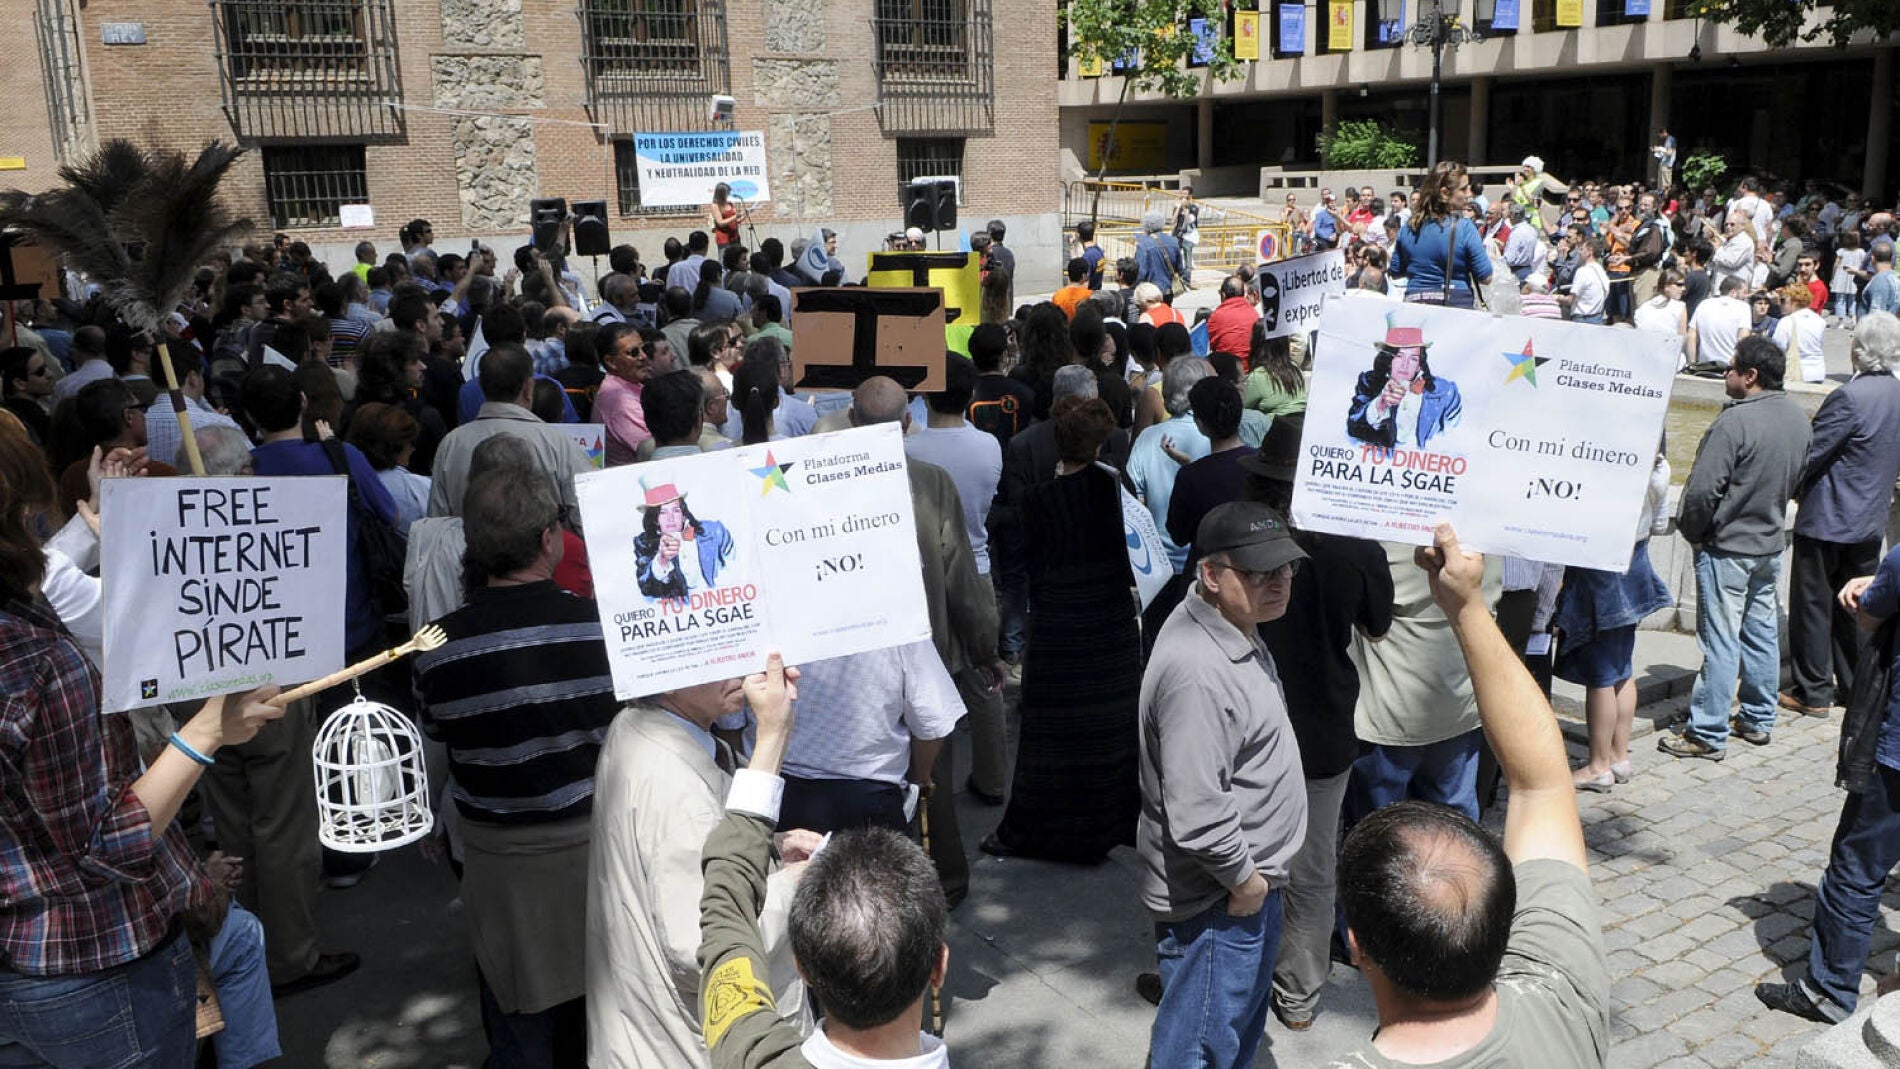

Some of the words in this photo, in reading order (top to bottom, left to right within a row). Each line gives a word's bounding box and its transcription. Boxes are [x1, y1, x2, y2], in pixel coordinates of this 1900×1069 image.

[637, 138, 656, 149] POR
[659, 138, 676, 149] LOS
[678, 137, 724, 148] DERECHOS
[660, 153, 671, 163] LA
[673, 151, 743, 163] UNIVERSALIDAD
[647, 168, 653, 179] Y
[655, 167, 716, 179] NEUTRALIDAD
[719, 166, 729, 176] DE
[731, 166, 742, 177] LA
[744, 165, 760, 176] RED
[1331, 261, 1343, 281] de
[1559, 359, 1633, 380] Plataforma
[1556, 375, 1605, 391] Clases
[1608, 382, 1663, 399] Medias
[1310, 445, 1354, 461] QUIERO
[1360, 443, 1386, 465] TU
[1392, 450, 1467, 476] DINERO
[1488, 430, 1531, 451] Con
[1537, 438, 1566, 457] mi
[1571, 441, 1639, 467] dinero
[803, 452, 870, 471] Plataforma
[806, 468, 851, 485] Clases
[854, 460, 903, 477] Medias
[1312, 460, 1363, 483] PARA
[1369, 466, 1395, 486] LA
[1401, 469, 1456, 494] $GAE
[1526, 478, 1582, 501] ¡NO!
[177, 486, 279, 528] FREE
[765, 528, 806, 547] Con
[811, 518, 836, 539] mi
[841, 511, 900, 534] dinero
[816, 553, 864, 582] ¡NO!
[614, 607, 655, 625] QUIERO
[658, 595, 683, 616] TU
[691, 583, 757, 611] DINERO
[620, 618, 671, 642] PARA
[675, 614, 700, 633] LA
[704, 603, 754, 628] $GAE
